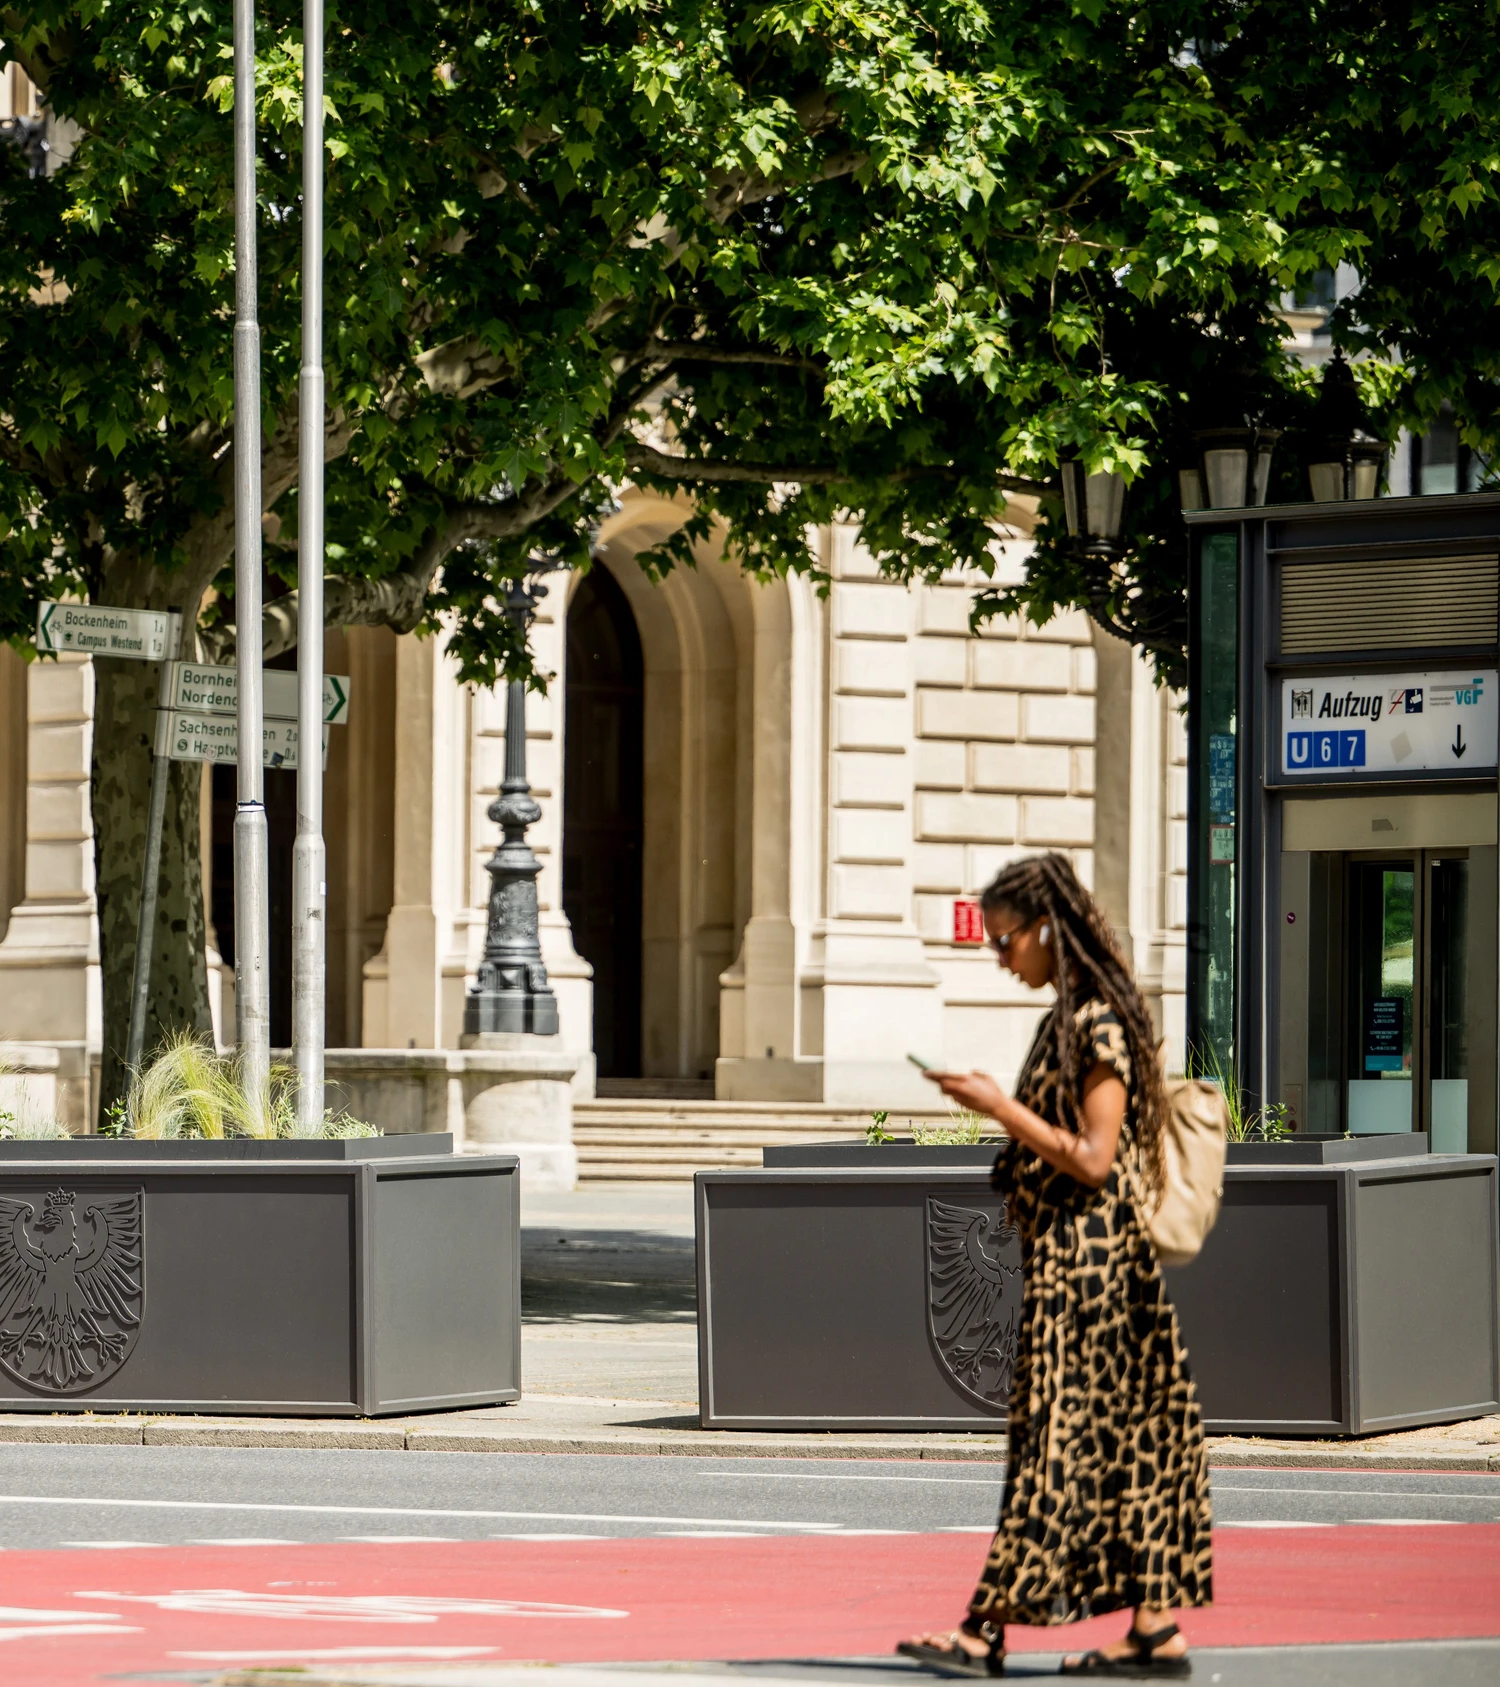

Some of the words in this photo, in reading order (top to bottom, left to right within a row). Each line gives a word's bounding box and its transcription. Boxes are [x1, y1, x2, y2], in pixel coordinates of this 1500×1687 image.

[65, 611, 128, 630] Bockenheim
[77, 632, 107, 649] Campus
[110, 634, 142, 650] Westend
[183, 669, 237, 688] Bornhei
[1318, 691, 1383, 722] Aufzug
[1291, 737, 1308, 763] U
[1321, 737, 1331, 762] 6
[1347, 736, 1358, 761] 7
